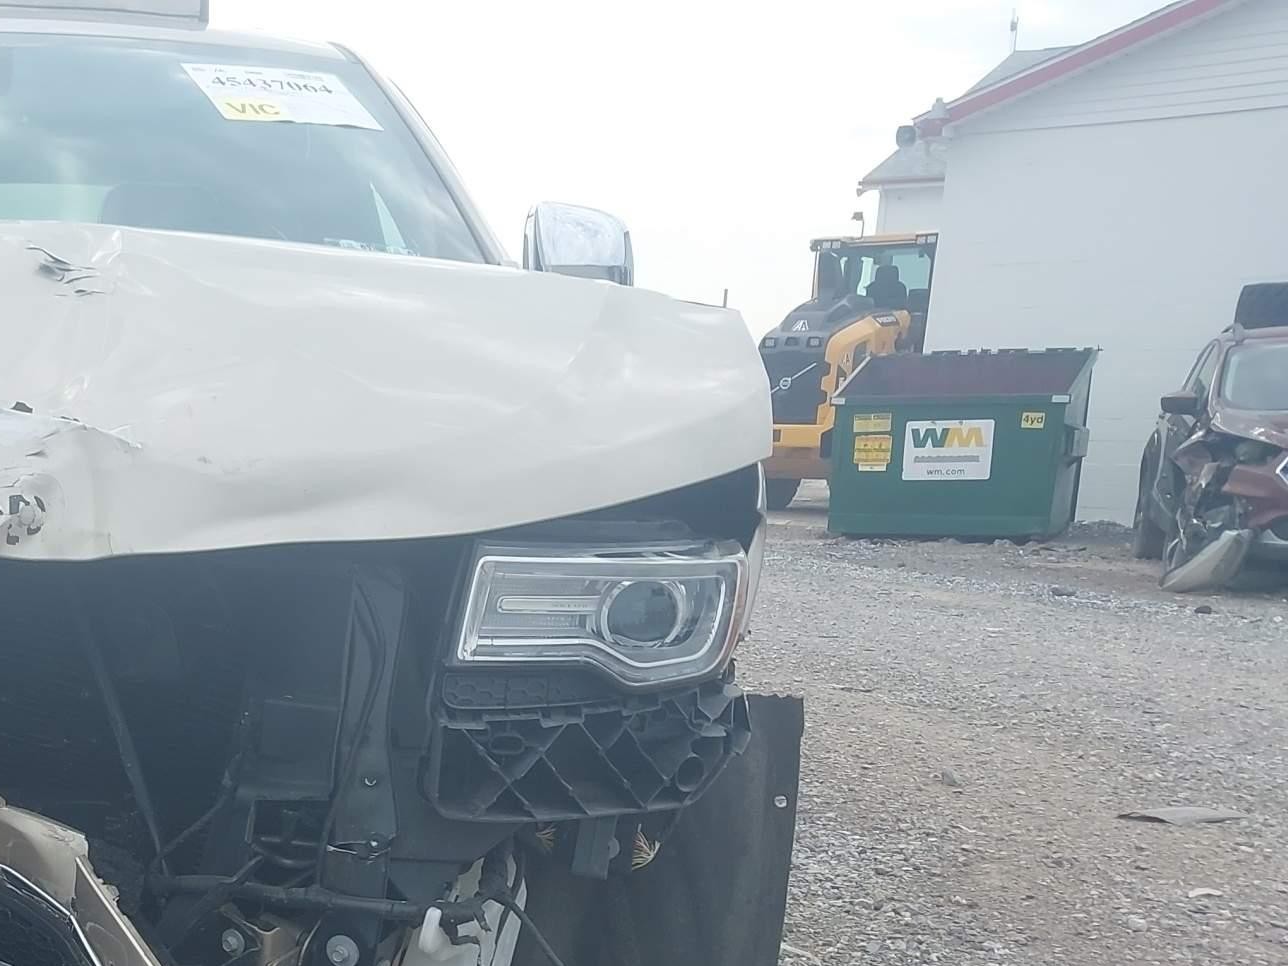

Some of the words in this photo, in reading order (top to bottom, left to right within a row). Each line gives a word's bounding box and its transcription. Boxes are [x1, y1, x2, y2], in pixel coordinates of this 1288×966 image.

[225, 101, 281, 116] VIC
[1022, 413, 1045, 426] 4yd
[911, 427, 985, 449] WM
[926, 467, 966, 476] wm.com
